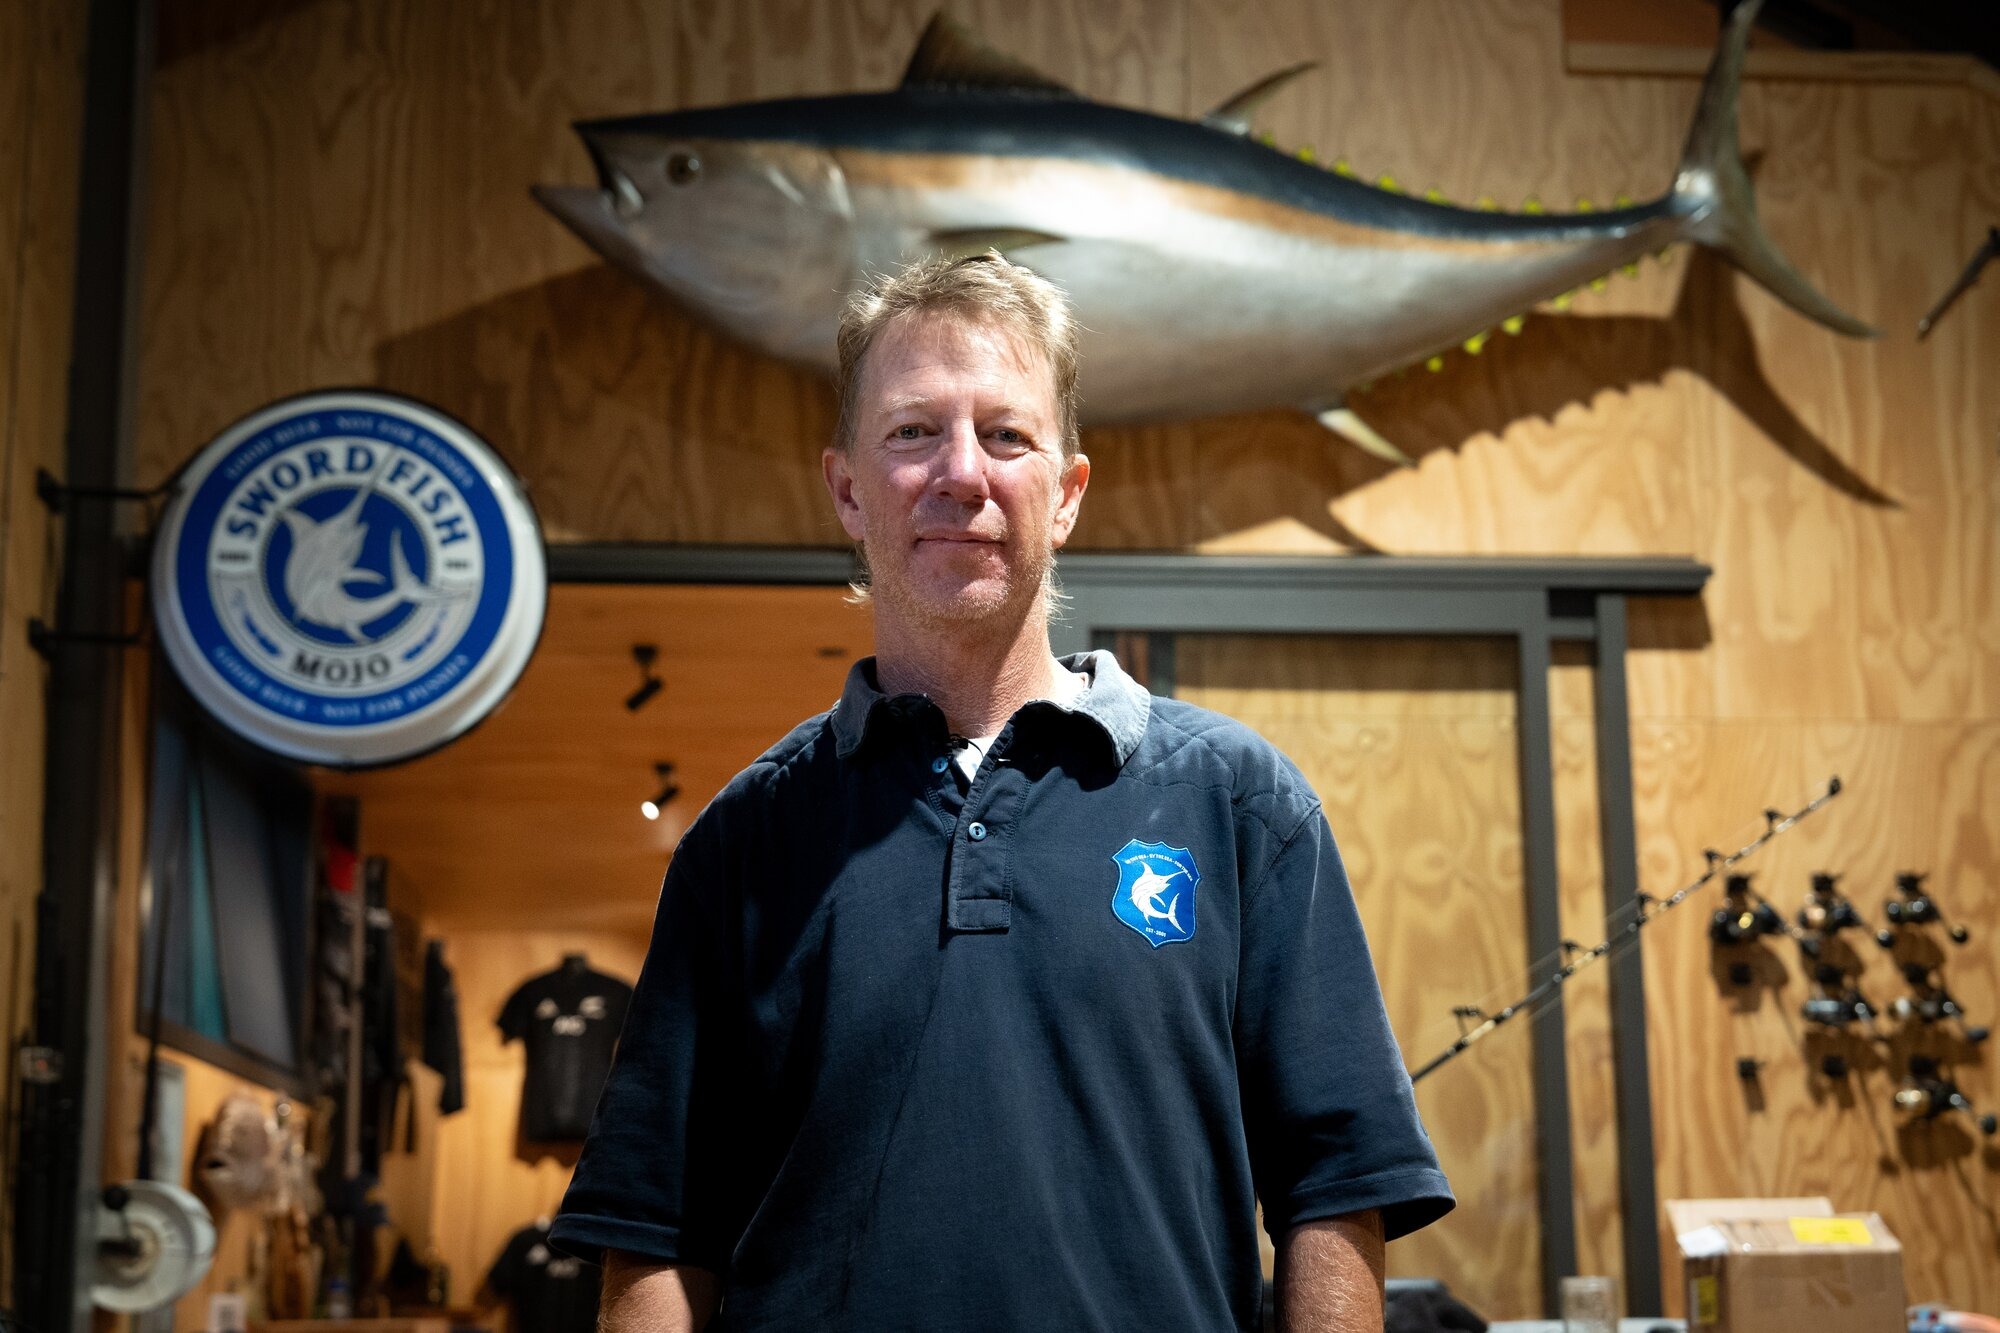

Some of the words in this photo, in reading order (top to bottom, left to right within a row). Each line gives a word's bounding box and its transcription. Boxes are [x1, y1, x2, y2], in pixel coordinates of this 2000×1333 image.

[337, 417, 373, 431] NOT
[378, 421, 414, 443] FOR
[230, 446, 374, 539] SWORD
[388, 461, 468, 547] FISH
[294, 654, 390, 686] MOJO
[322, 702, 360, 719] NOT
[365, 695, 404, 717] FOR
